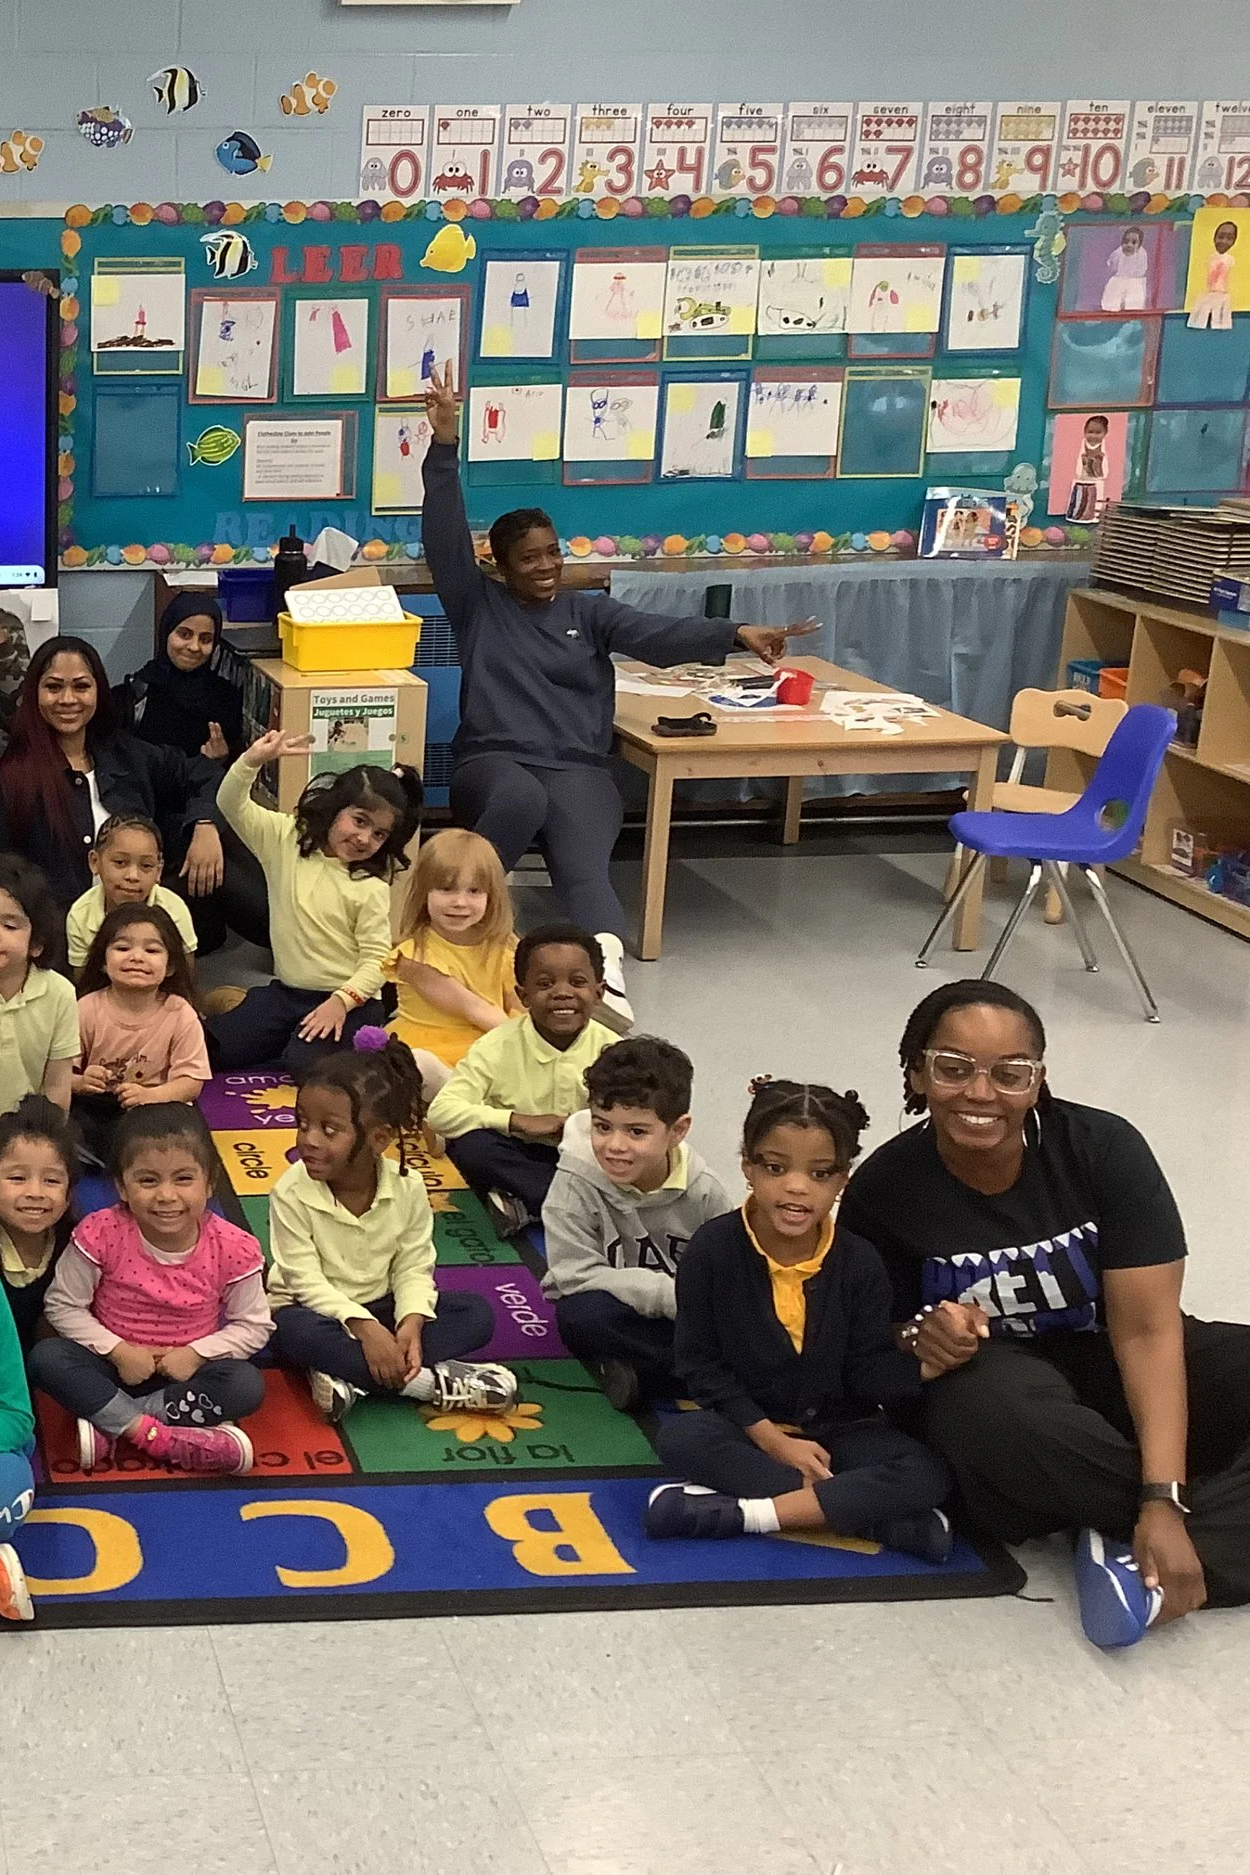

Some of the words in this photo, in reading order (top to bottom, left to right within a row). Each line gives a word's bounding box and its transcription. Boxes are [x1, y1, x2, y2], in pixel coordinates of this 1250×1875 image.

[381, 108, 411, 118] zero
[456, 108, 479, 118] one
[527, 105, 551, 117] two
[591, 103, 628, 116] three
[667, 103, 694, 116] four
[738, 103, 763, 116] five
[813, 105, 829, 115] six
[873, 106, 909, 115] seven
[945, 102, 975, 117] eight
[1017, 104, 1042, 114] nine
[1089, 102, 1109, 112] ten
[1147, 102, 1186, 114] eleven
[388, 149, 421, 198] 0
[479, 149, 491, 197] 1
[535, 148, 566, 196] 2
[605, 145, 635, 195] 3
[676, 145, 705, 194] 4
[746, 144, 778, 193] 5
[816, 144, 845, 193] 6
[885, 145, 914, 194] 7
[955, 144, 983, 193] 8
[1025, 144, 1052, 192] 9
[1078, 142, 1122, 191] 10
[1164, 156, 1185, 191] 11
[270, 244, 404, 284] LEER
[314, 695, 338, 705] Toys
[340, 694, 358, 703] and
[361, 694, 395, 703] Games
[314, 708, 354, 718] Juguetes
[362, 707, 393, 716] Juegos
[233, 1142, 272, 1179] circle
[444, 1211, 474, 1225] el
[445, 1227, 494, 1263] gato
[495, 1283, 549, 1337] verde
[307, 1448, 349, 1471] el
[444, 1440, 513, 1465] flor
[527, 1442, 576, 1465] la
[239, 1499, 395, 1588] C
[484, 1491, 638, 1577] B
